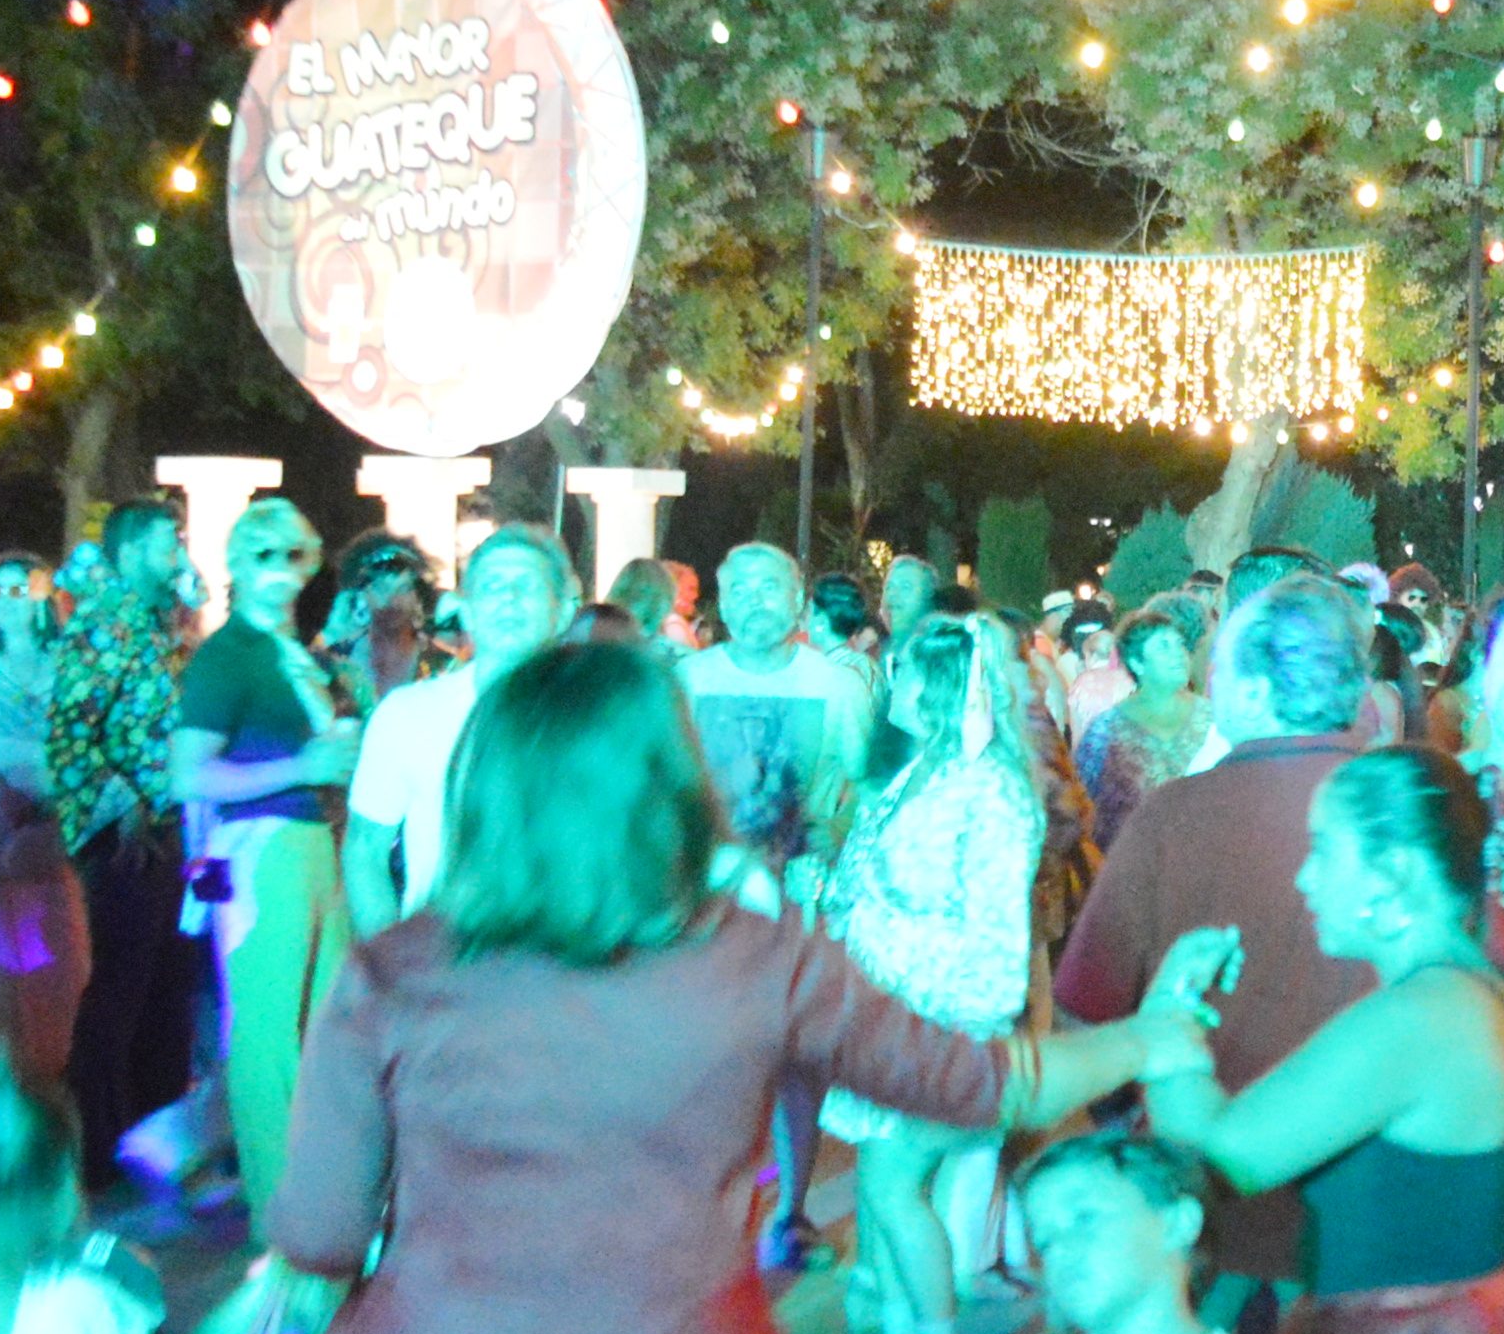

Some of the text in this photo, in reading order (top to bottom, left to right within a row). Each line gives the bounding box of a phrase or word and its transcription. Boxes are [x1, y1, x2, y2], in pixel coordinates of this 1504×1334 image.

[287, 17, 491, 97] EL MAYOR
[264, 72, 538, 197] GUATEQUE
[375, 168, 517, 241] mundo
